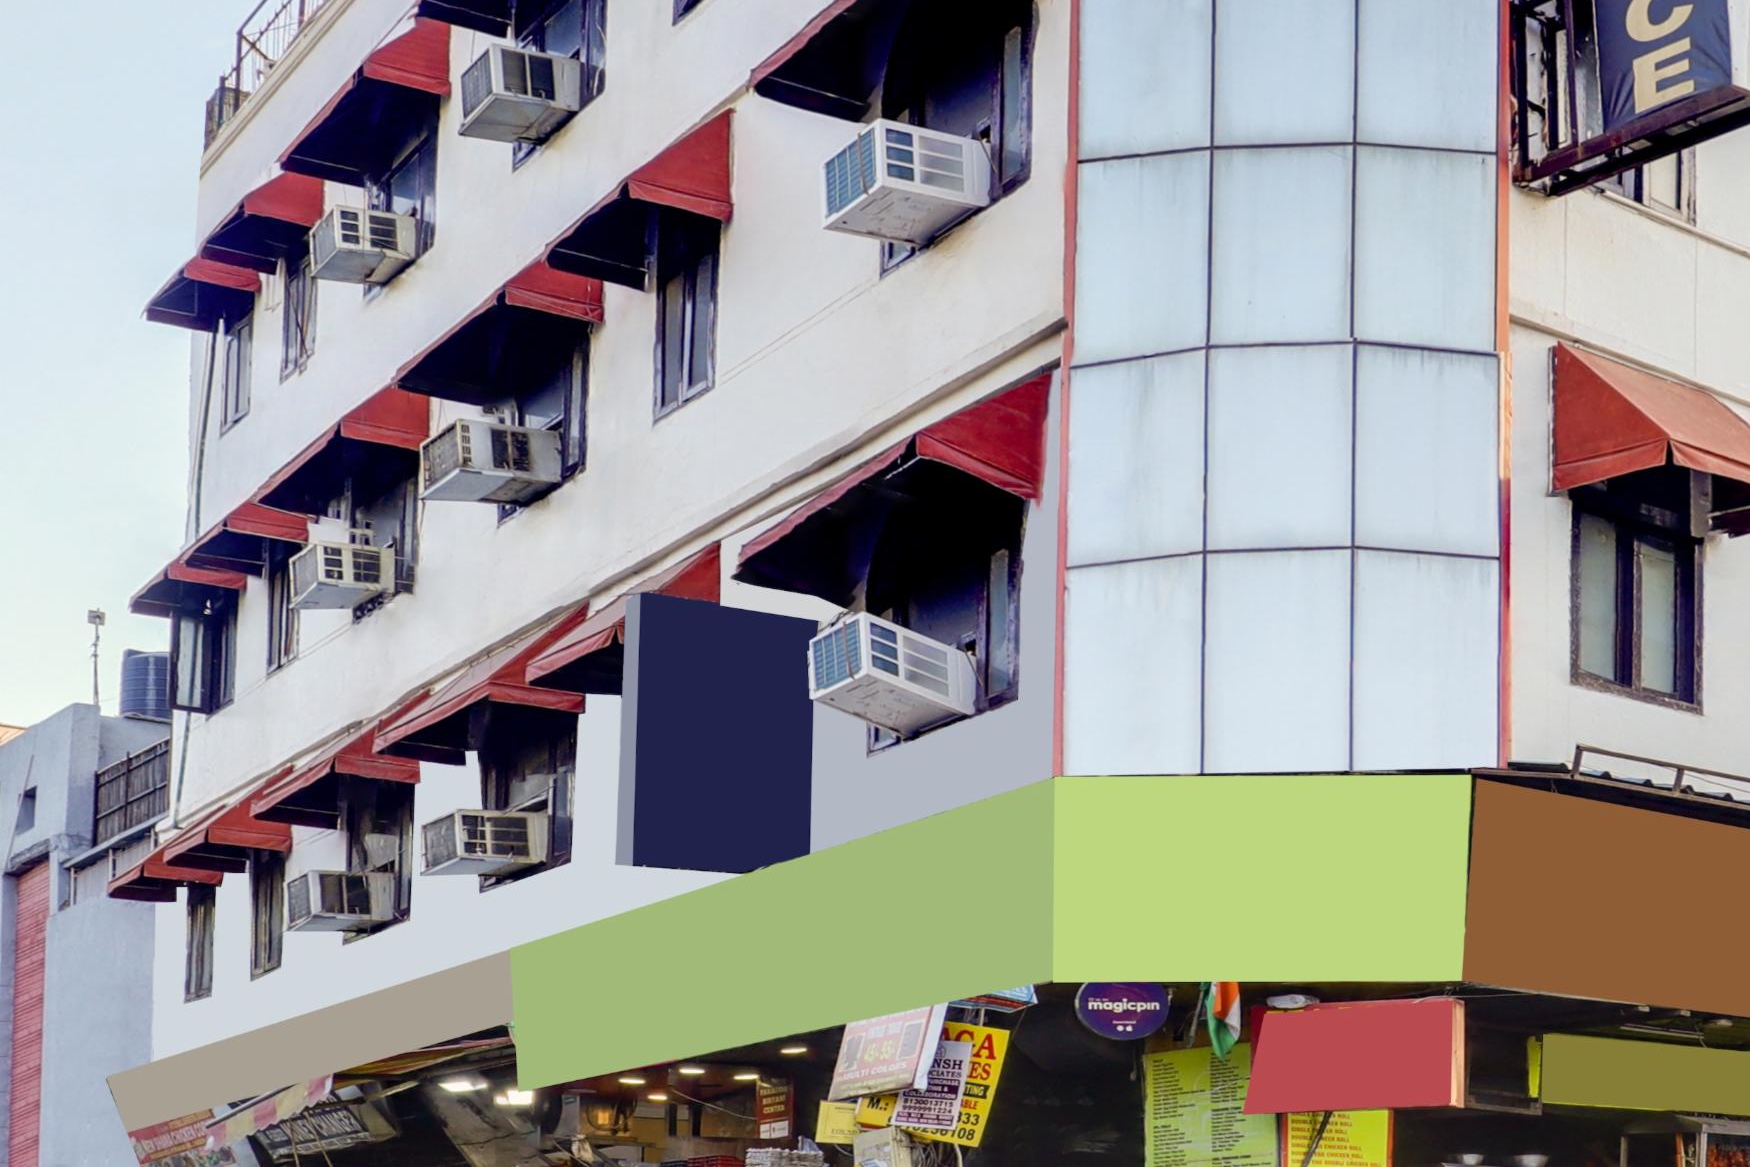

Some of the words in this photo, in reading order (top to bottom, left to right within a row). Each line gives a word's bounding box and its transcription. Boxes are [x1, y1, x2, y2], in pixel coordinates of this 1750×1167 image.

[1087, 998, 1160, 1013] magicpin
[932, 1058, 963, 1070] NSH
[928, 1069, 962, 1078] CIATES
[967, 1061, 992, 1081] ES
[965, 1084, 985, 1097] TING
